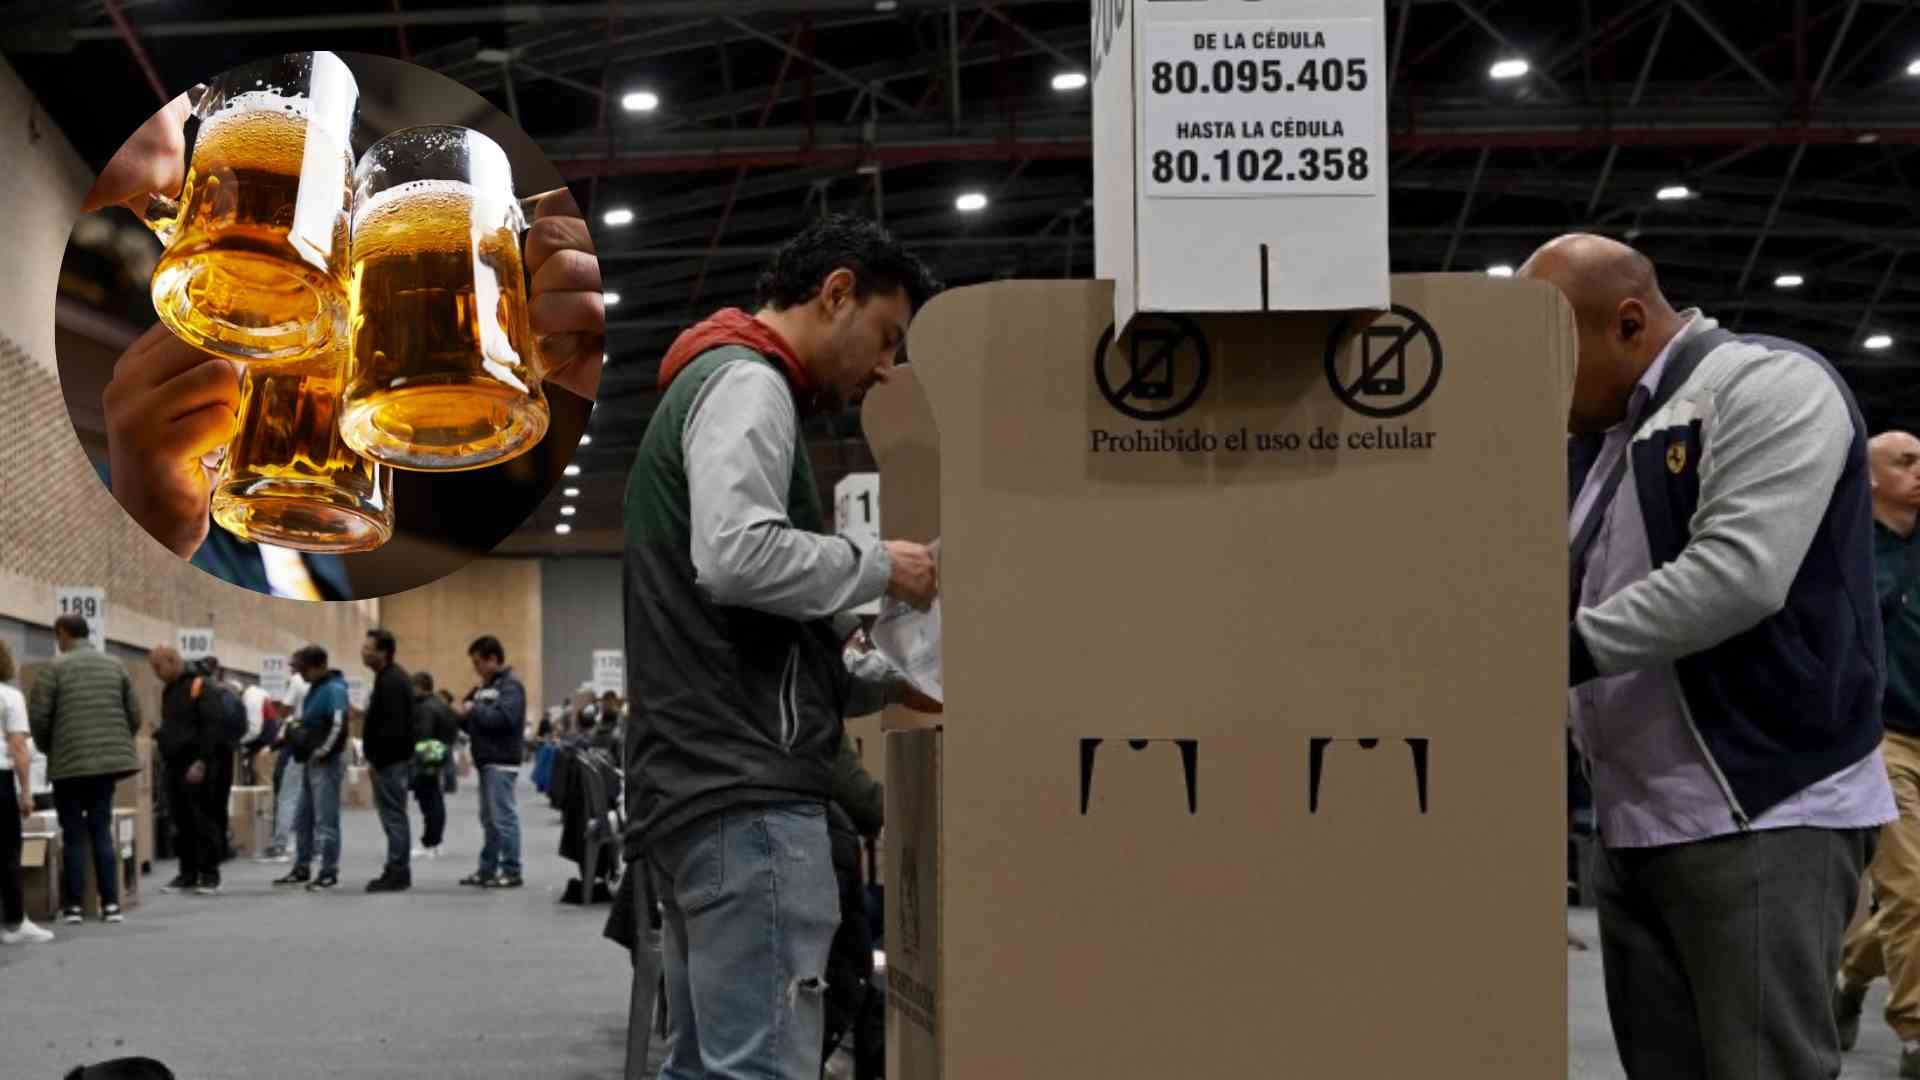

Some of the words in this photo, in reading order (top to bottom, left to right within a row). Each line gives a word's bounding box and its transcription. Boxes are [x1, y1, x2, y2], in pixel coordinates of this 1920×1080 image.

[1194, 33, 1216, 50] DE
[1224, 33, 1246, 49] LA
[1253, 28, 1326, 49] CÉDULA
[1152, 58, 1368, 94] 80.095.405
[1177, 121, 1236, 139] HASTA
[1242, 121, 1264, 138] LA
[1270, 116, 1344, 138] CÉDULA
[1152, 147, 1369, 183] 80.102.358
[1090, 428, 1217, 452] Prohibido
[1225, 428, 1247, 450] el
[1256, 433, 1300, 451] uso
[1308, 427, 1339, 450] de
[1347, 426, 1436, 450] celular
[60, 597, 96, 617] 189
